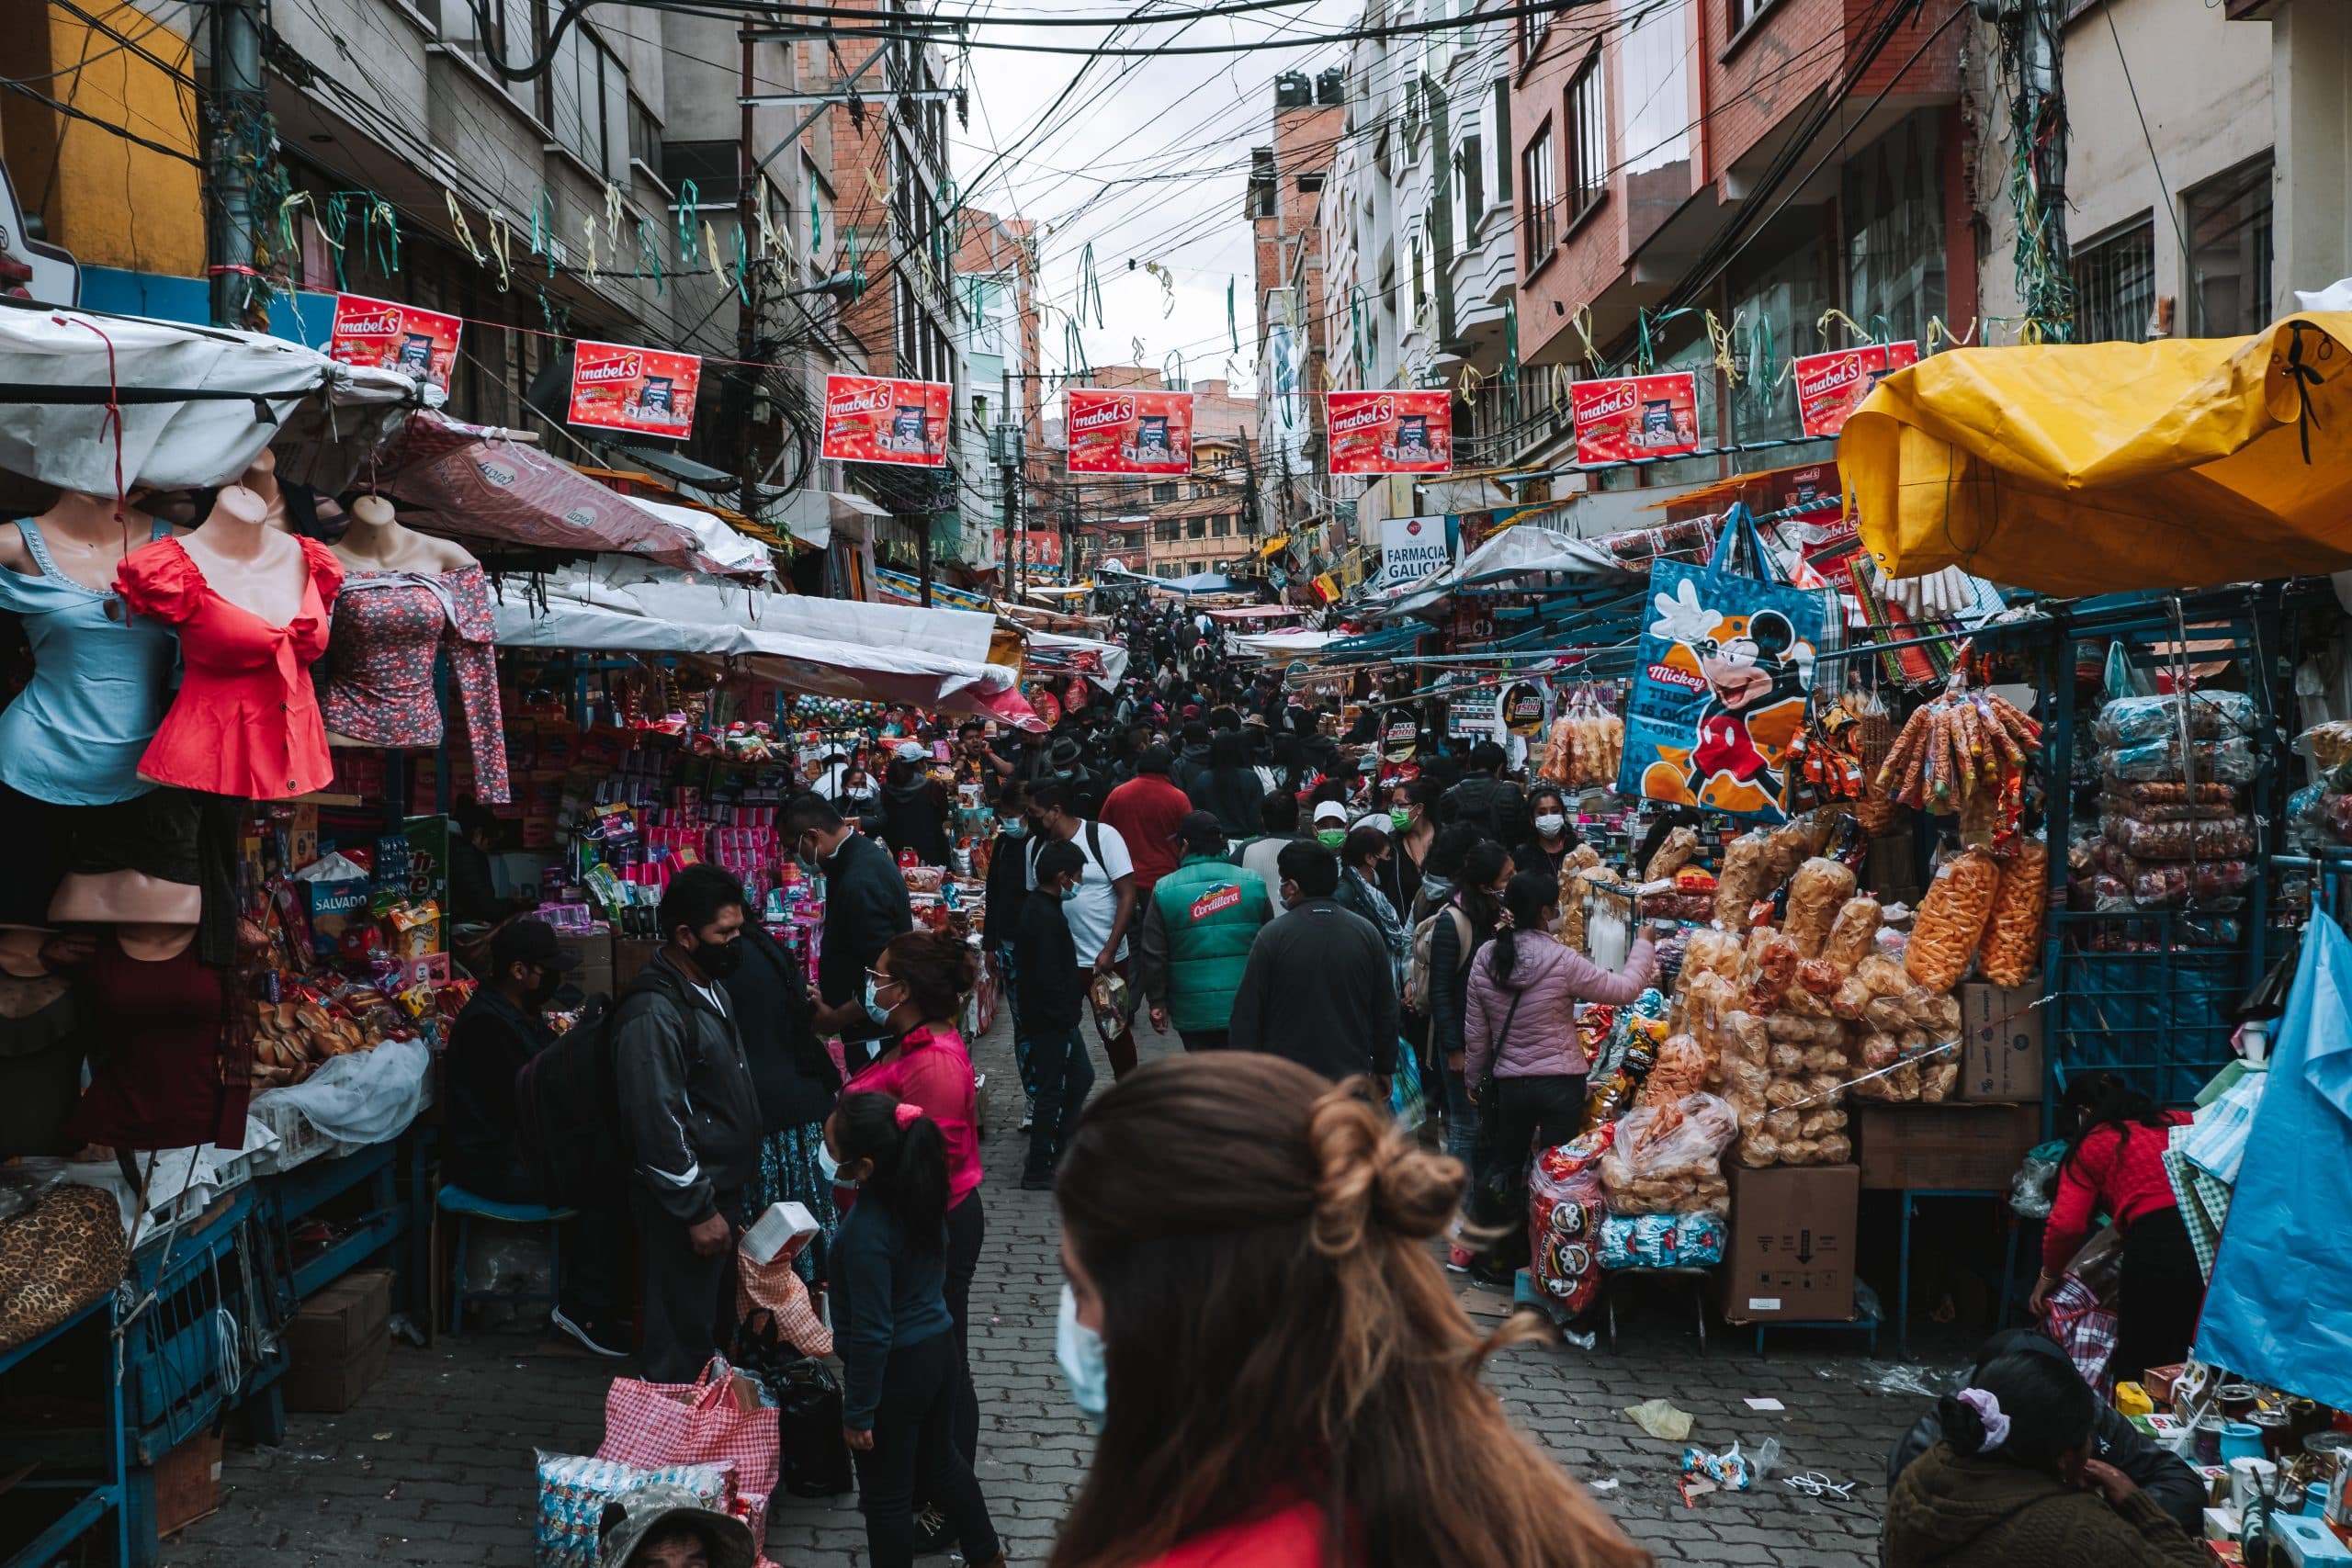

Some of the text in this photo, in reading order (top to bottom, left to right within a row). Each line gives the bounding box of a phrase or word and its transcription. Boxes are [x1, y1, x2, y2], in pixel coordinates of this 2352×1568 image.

[1387, 546, 1445, 562] FARMACIA
[1388, 561, 1444, 579] GALICI
[1649, 665, 1704, 692] Mickey
[1516, 704, 1541, 714] 1500
[1389, 728, 1416, 738] 3000
[1654, 725, 1685, 739] ONE
[316, 896, 367, 910] SALVADO
[1193, 892, 1238, 917] Cordillera
